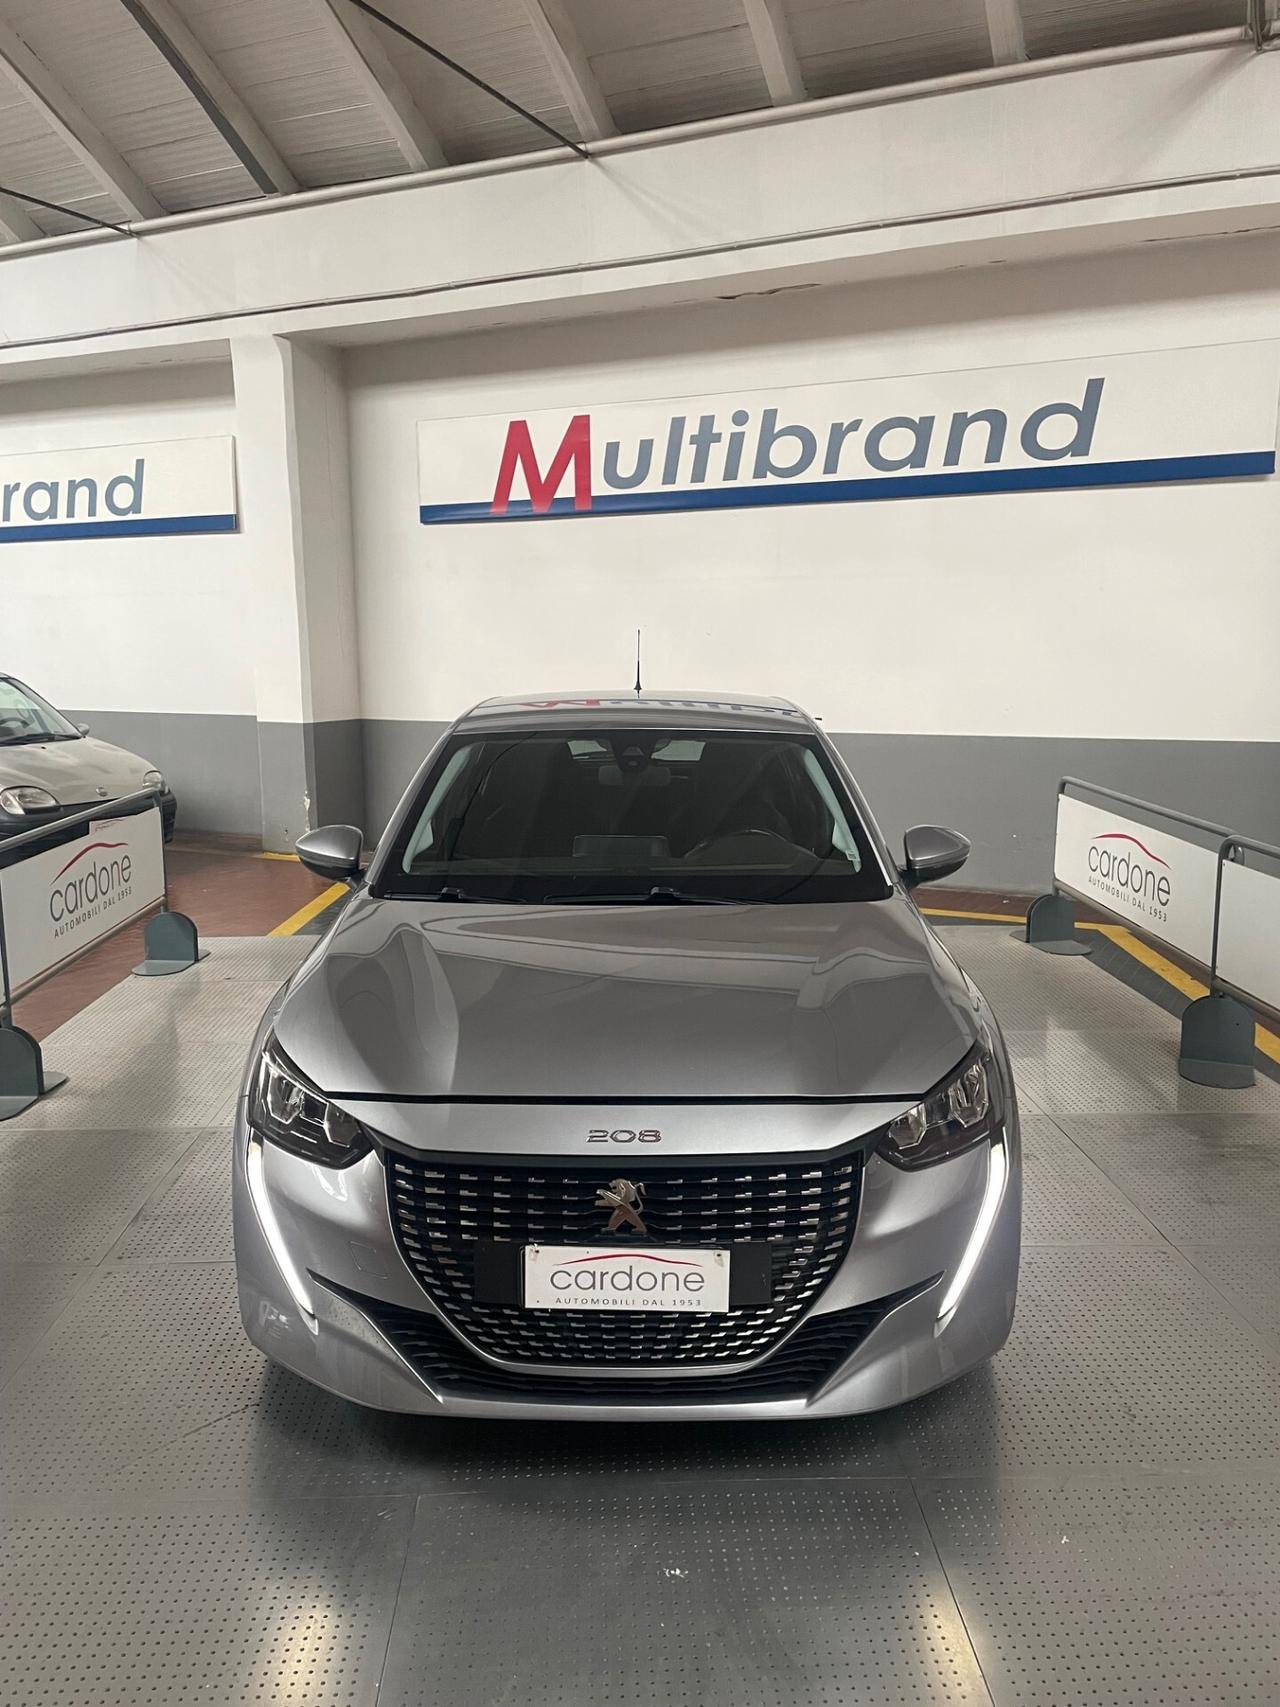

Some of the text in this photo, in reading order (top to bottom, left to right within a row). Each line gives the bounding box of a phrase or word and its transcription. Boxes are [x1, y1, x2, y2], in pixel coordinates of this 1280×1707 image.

[489, 377, 1105, 516] Multibrand
[50, 854, 131, 922] cardone
[1088, 846, 1171, 907] cardone
[1088, 875, 1167, 922] AUTOMOBILI DAL 1953
[54, 886, 132, 939] AUTOMOBILI DAL 1953
[586, 1129, 662, 1143] 208
[550, 1265, 705, 1292] cardone
[555, 1297, 635, 1306] AUTOMOBILI
